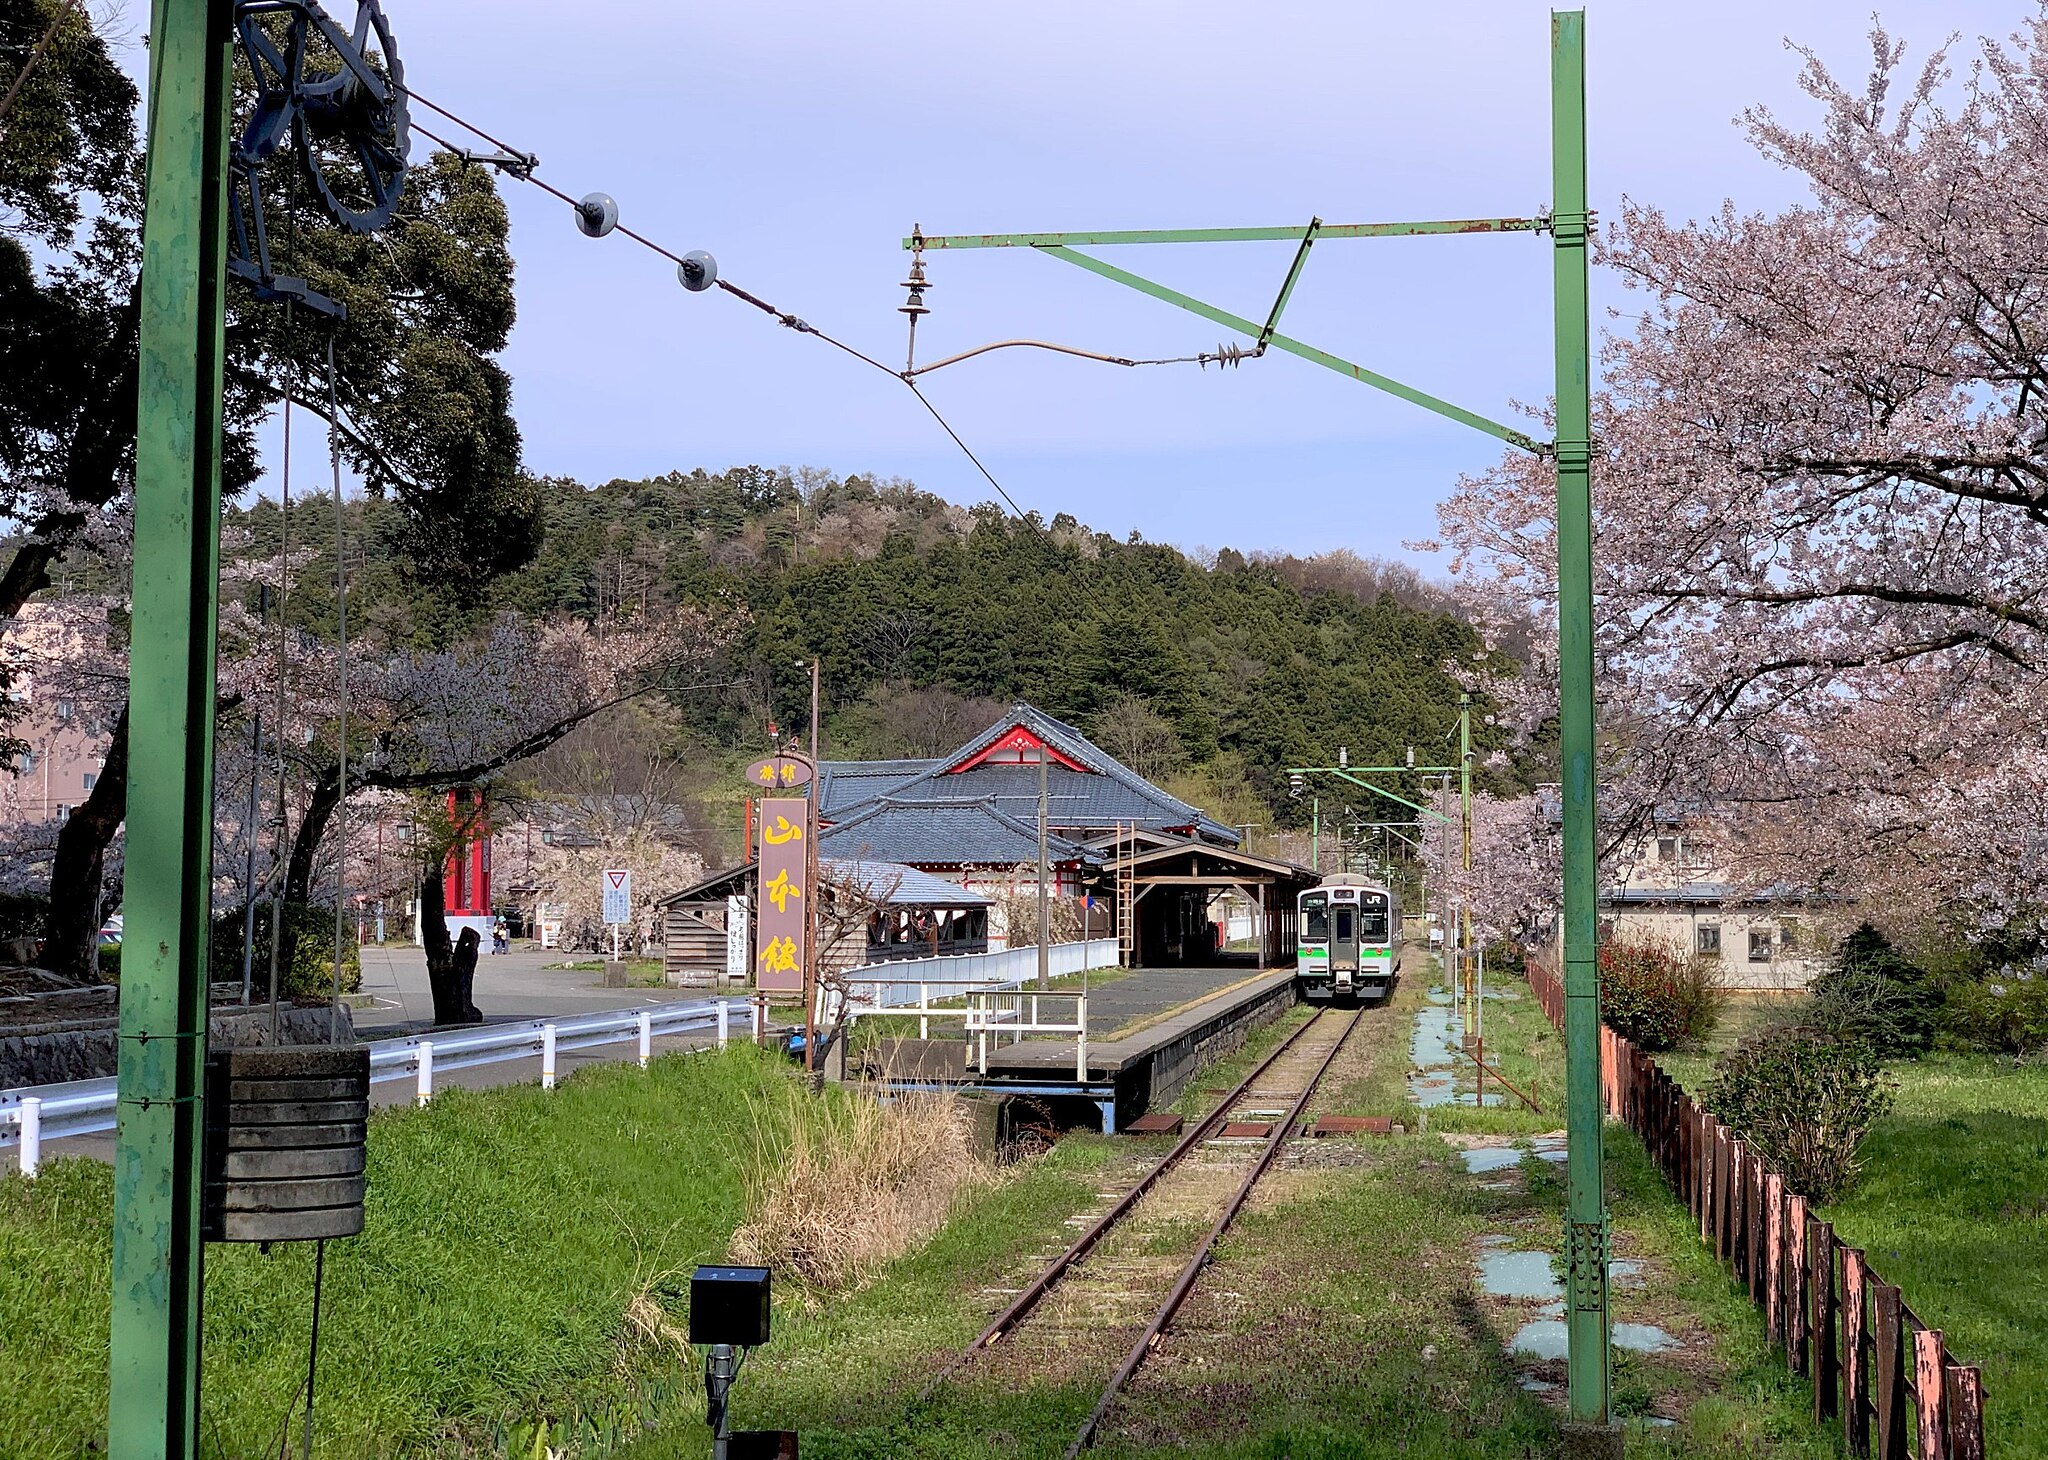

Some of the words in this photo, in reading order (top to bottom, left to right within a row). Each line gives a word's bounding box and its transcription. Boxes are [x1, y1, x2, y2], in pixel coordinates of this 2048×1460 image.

[759, 763, 796, 783] 旅館
[760, 815, 803, 974] 山本館
[1366, 895, 1381, 904] JR
